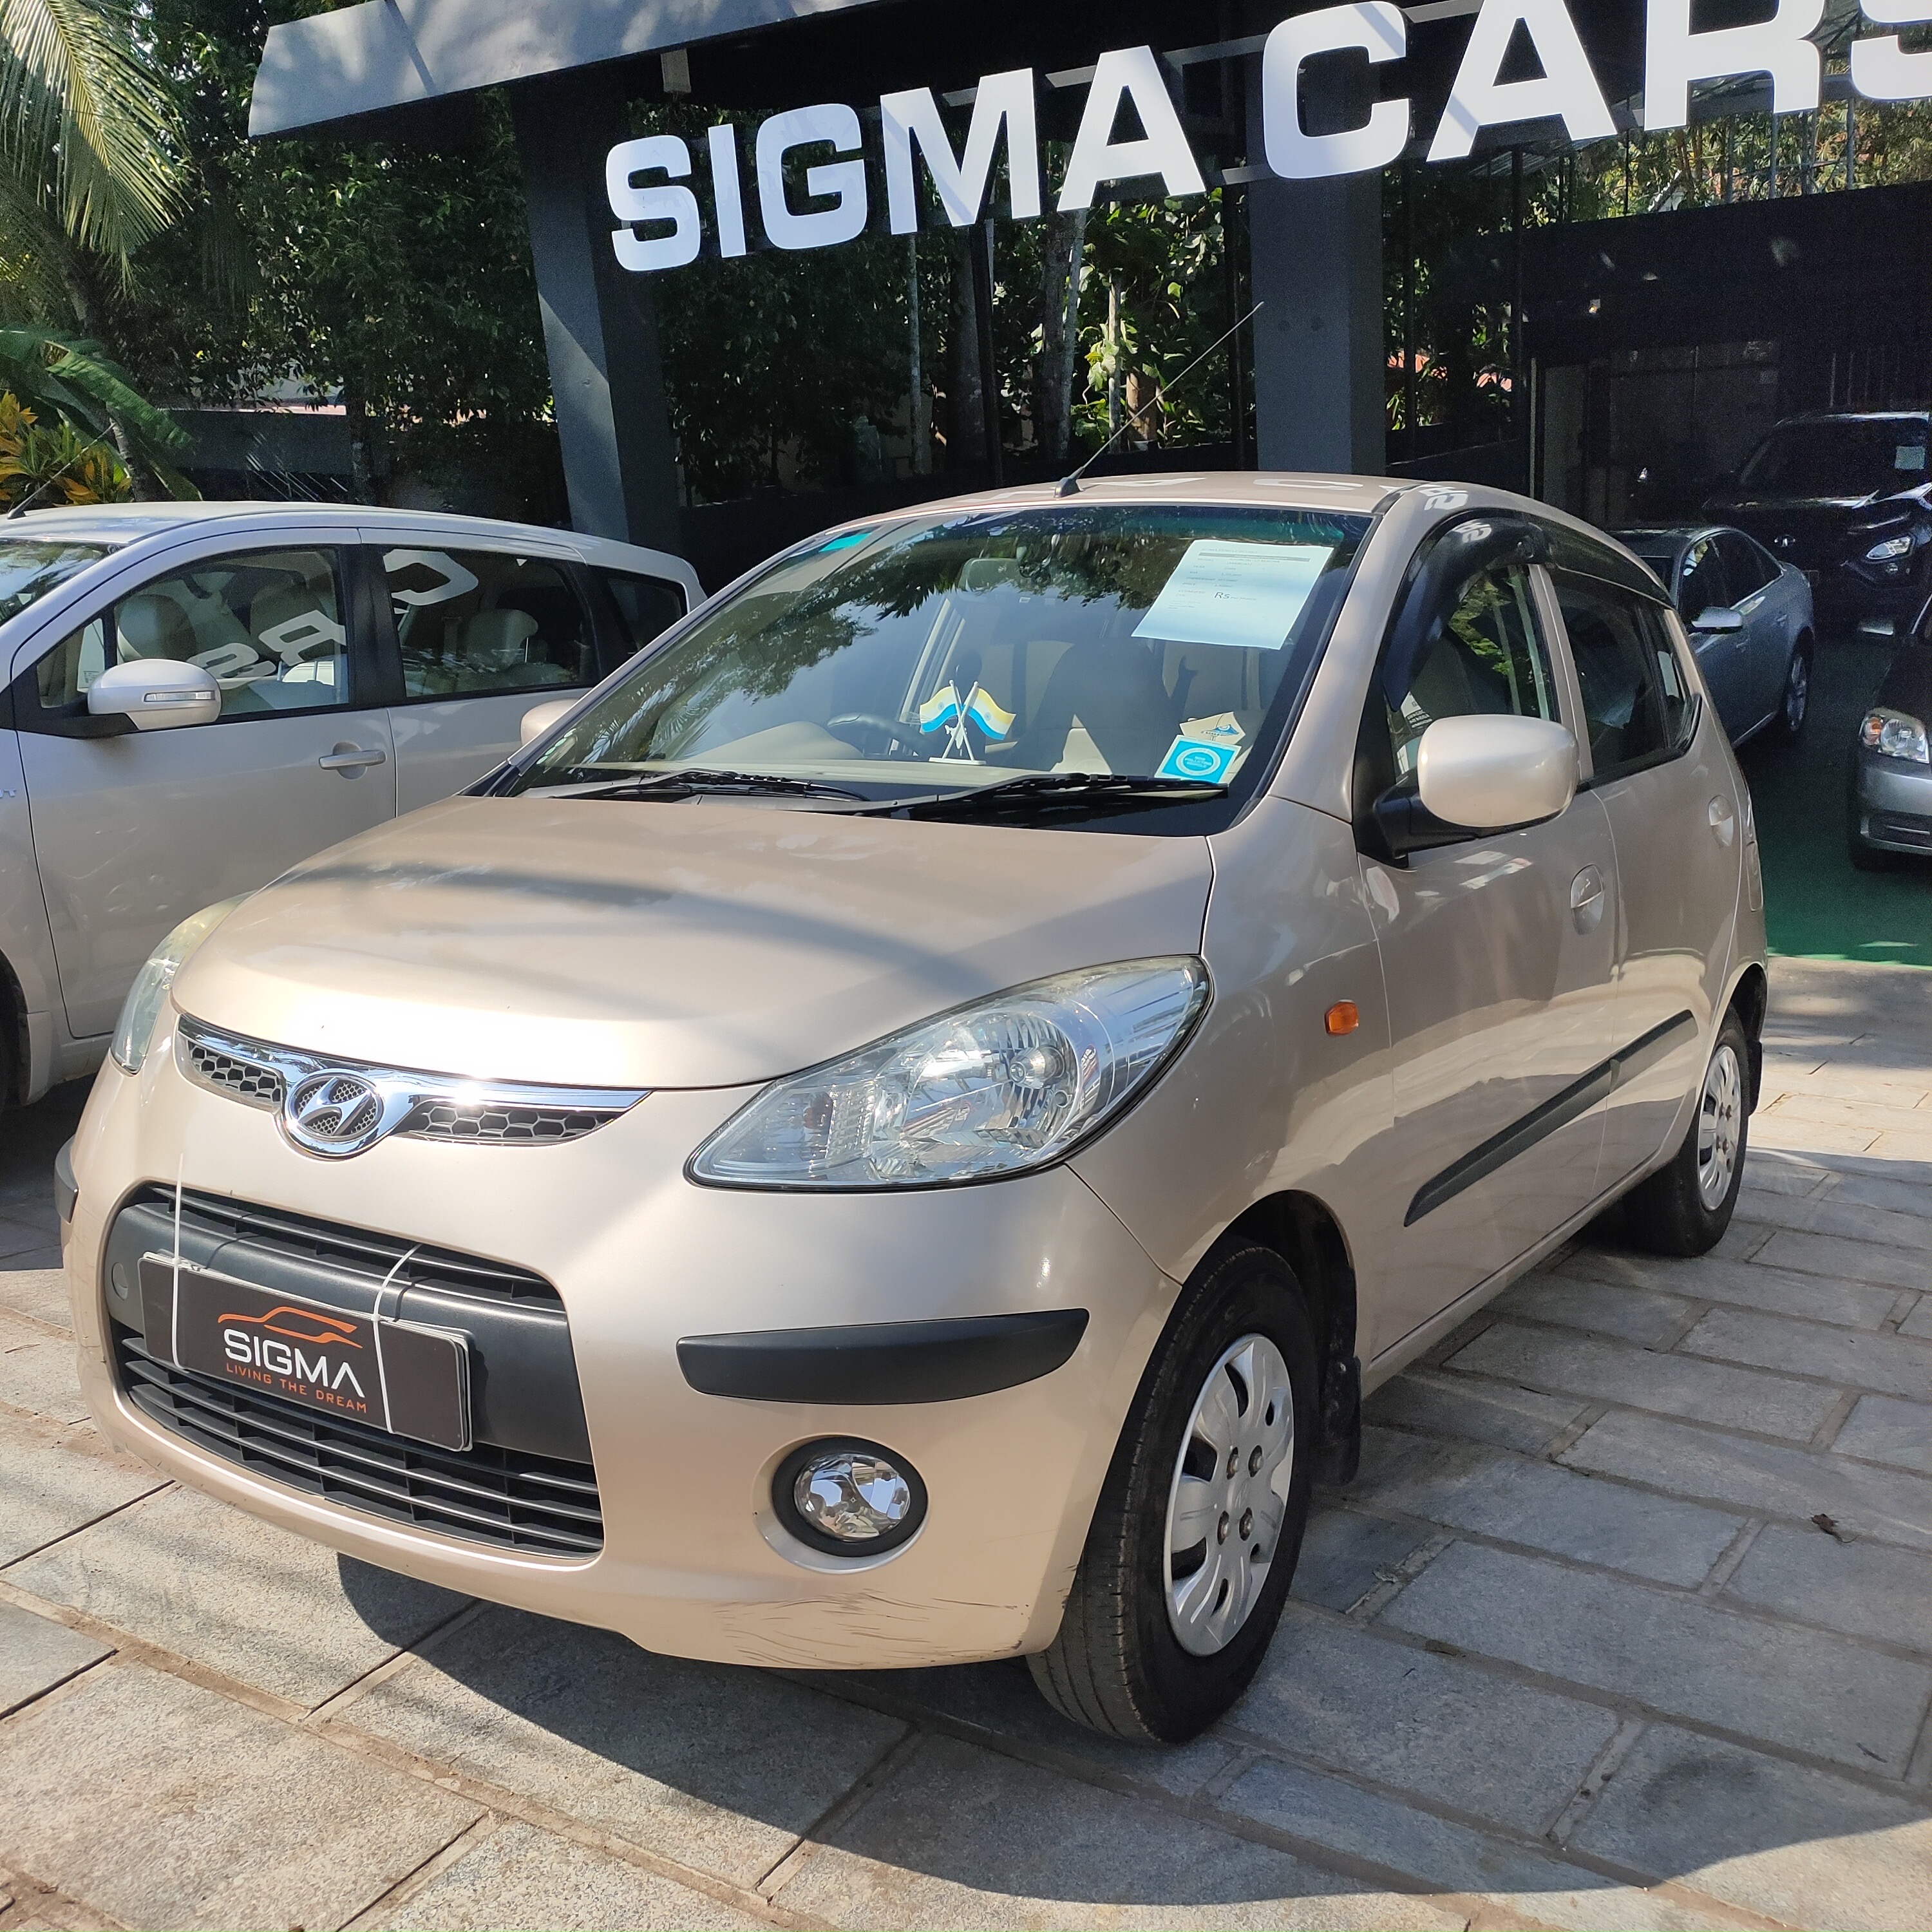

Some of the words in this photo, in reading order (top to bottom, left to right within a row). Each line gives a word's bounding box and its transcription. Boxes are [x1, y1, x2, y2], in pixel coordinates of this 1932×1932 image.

[605, 44, 1206, 272] SIGMA
[1262, 0, 1932, 180] CAR
[223, 1328, 365, 1398] SIGMA
[226, 1363, 272, 1384] LIVING
[279, 1378, 307, 1396] THE
[316, 1390, 367, 1414] DREAM
